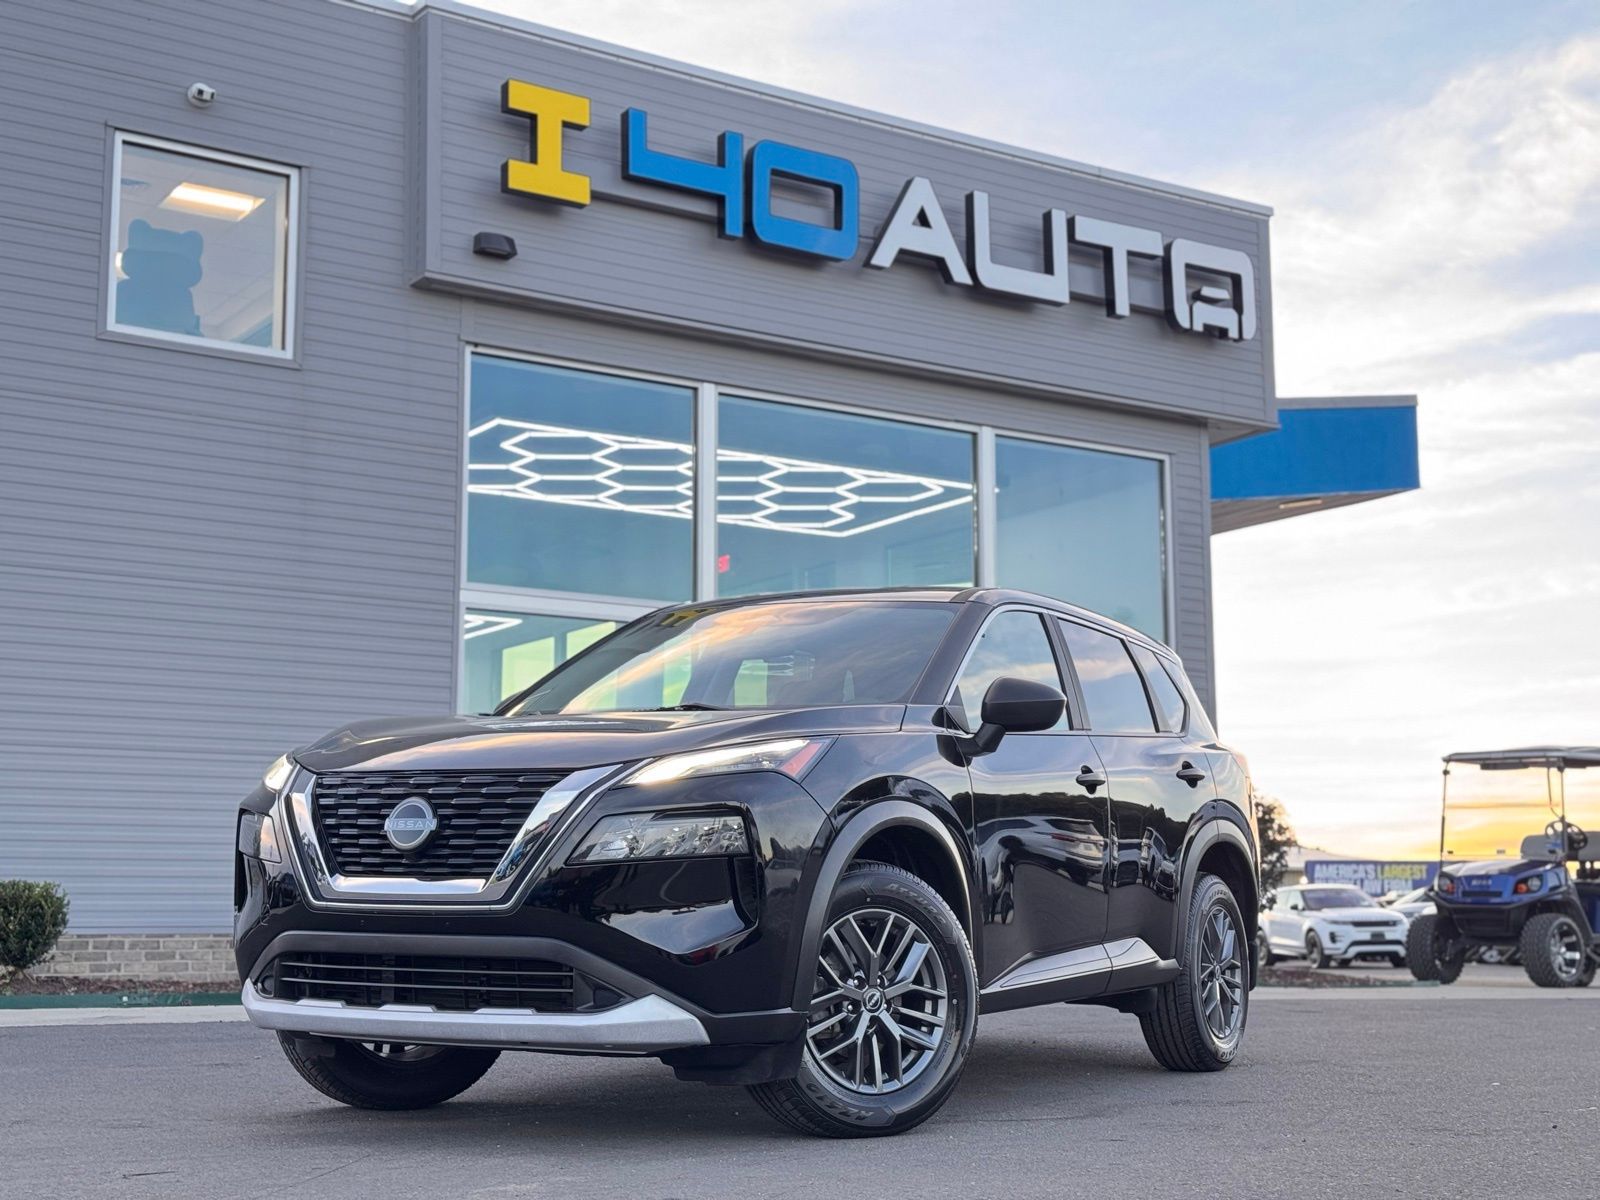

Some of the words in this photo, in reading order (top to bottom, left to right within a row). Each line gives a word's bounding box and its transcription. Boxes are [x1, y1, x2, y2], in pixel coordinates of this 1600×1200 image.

[387, 820, 434, 829] NISSAN
[1314, 864, 1375, 879] AMERICA'S
[1376, 863, 1427, 879] LARGEST
